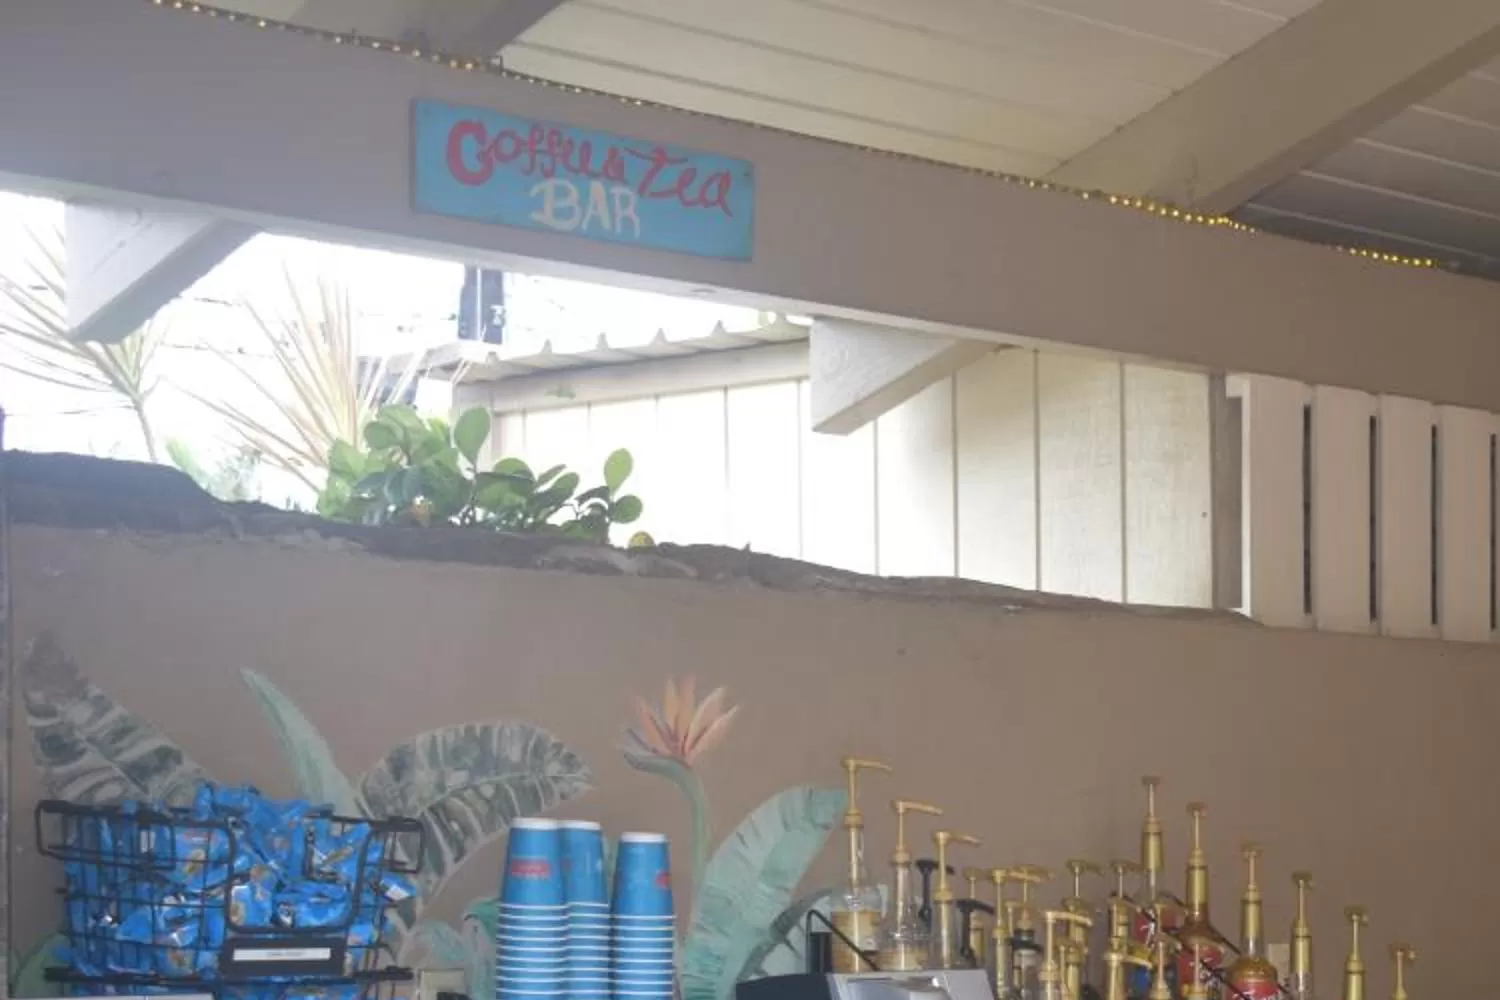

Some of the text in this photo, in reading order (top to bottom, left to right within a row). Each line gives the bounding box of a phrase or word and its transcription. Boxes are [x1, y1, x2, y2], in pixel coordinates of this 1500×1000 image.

[447, 119, 597, 186] Coffee
[622, 146, 733, 217] Tea
[529, 177, 640, 238] BAR
